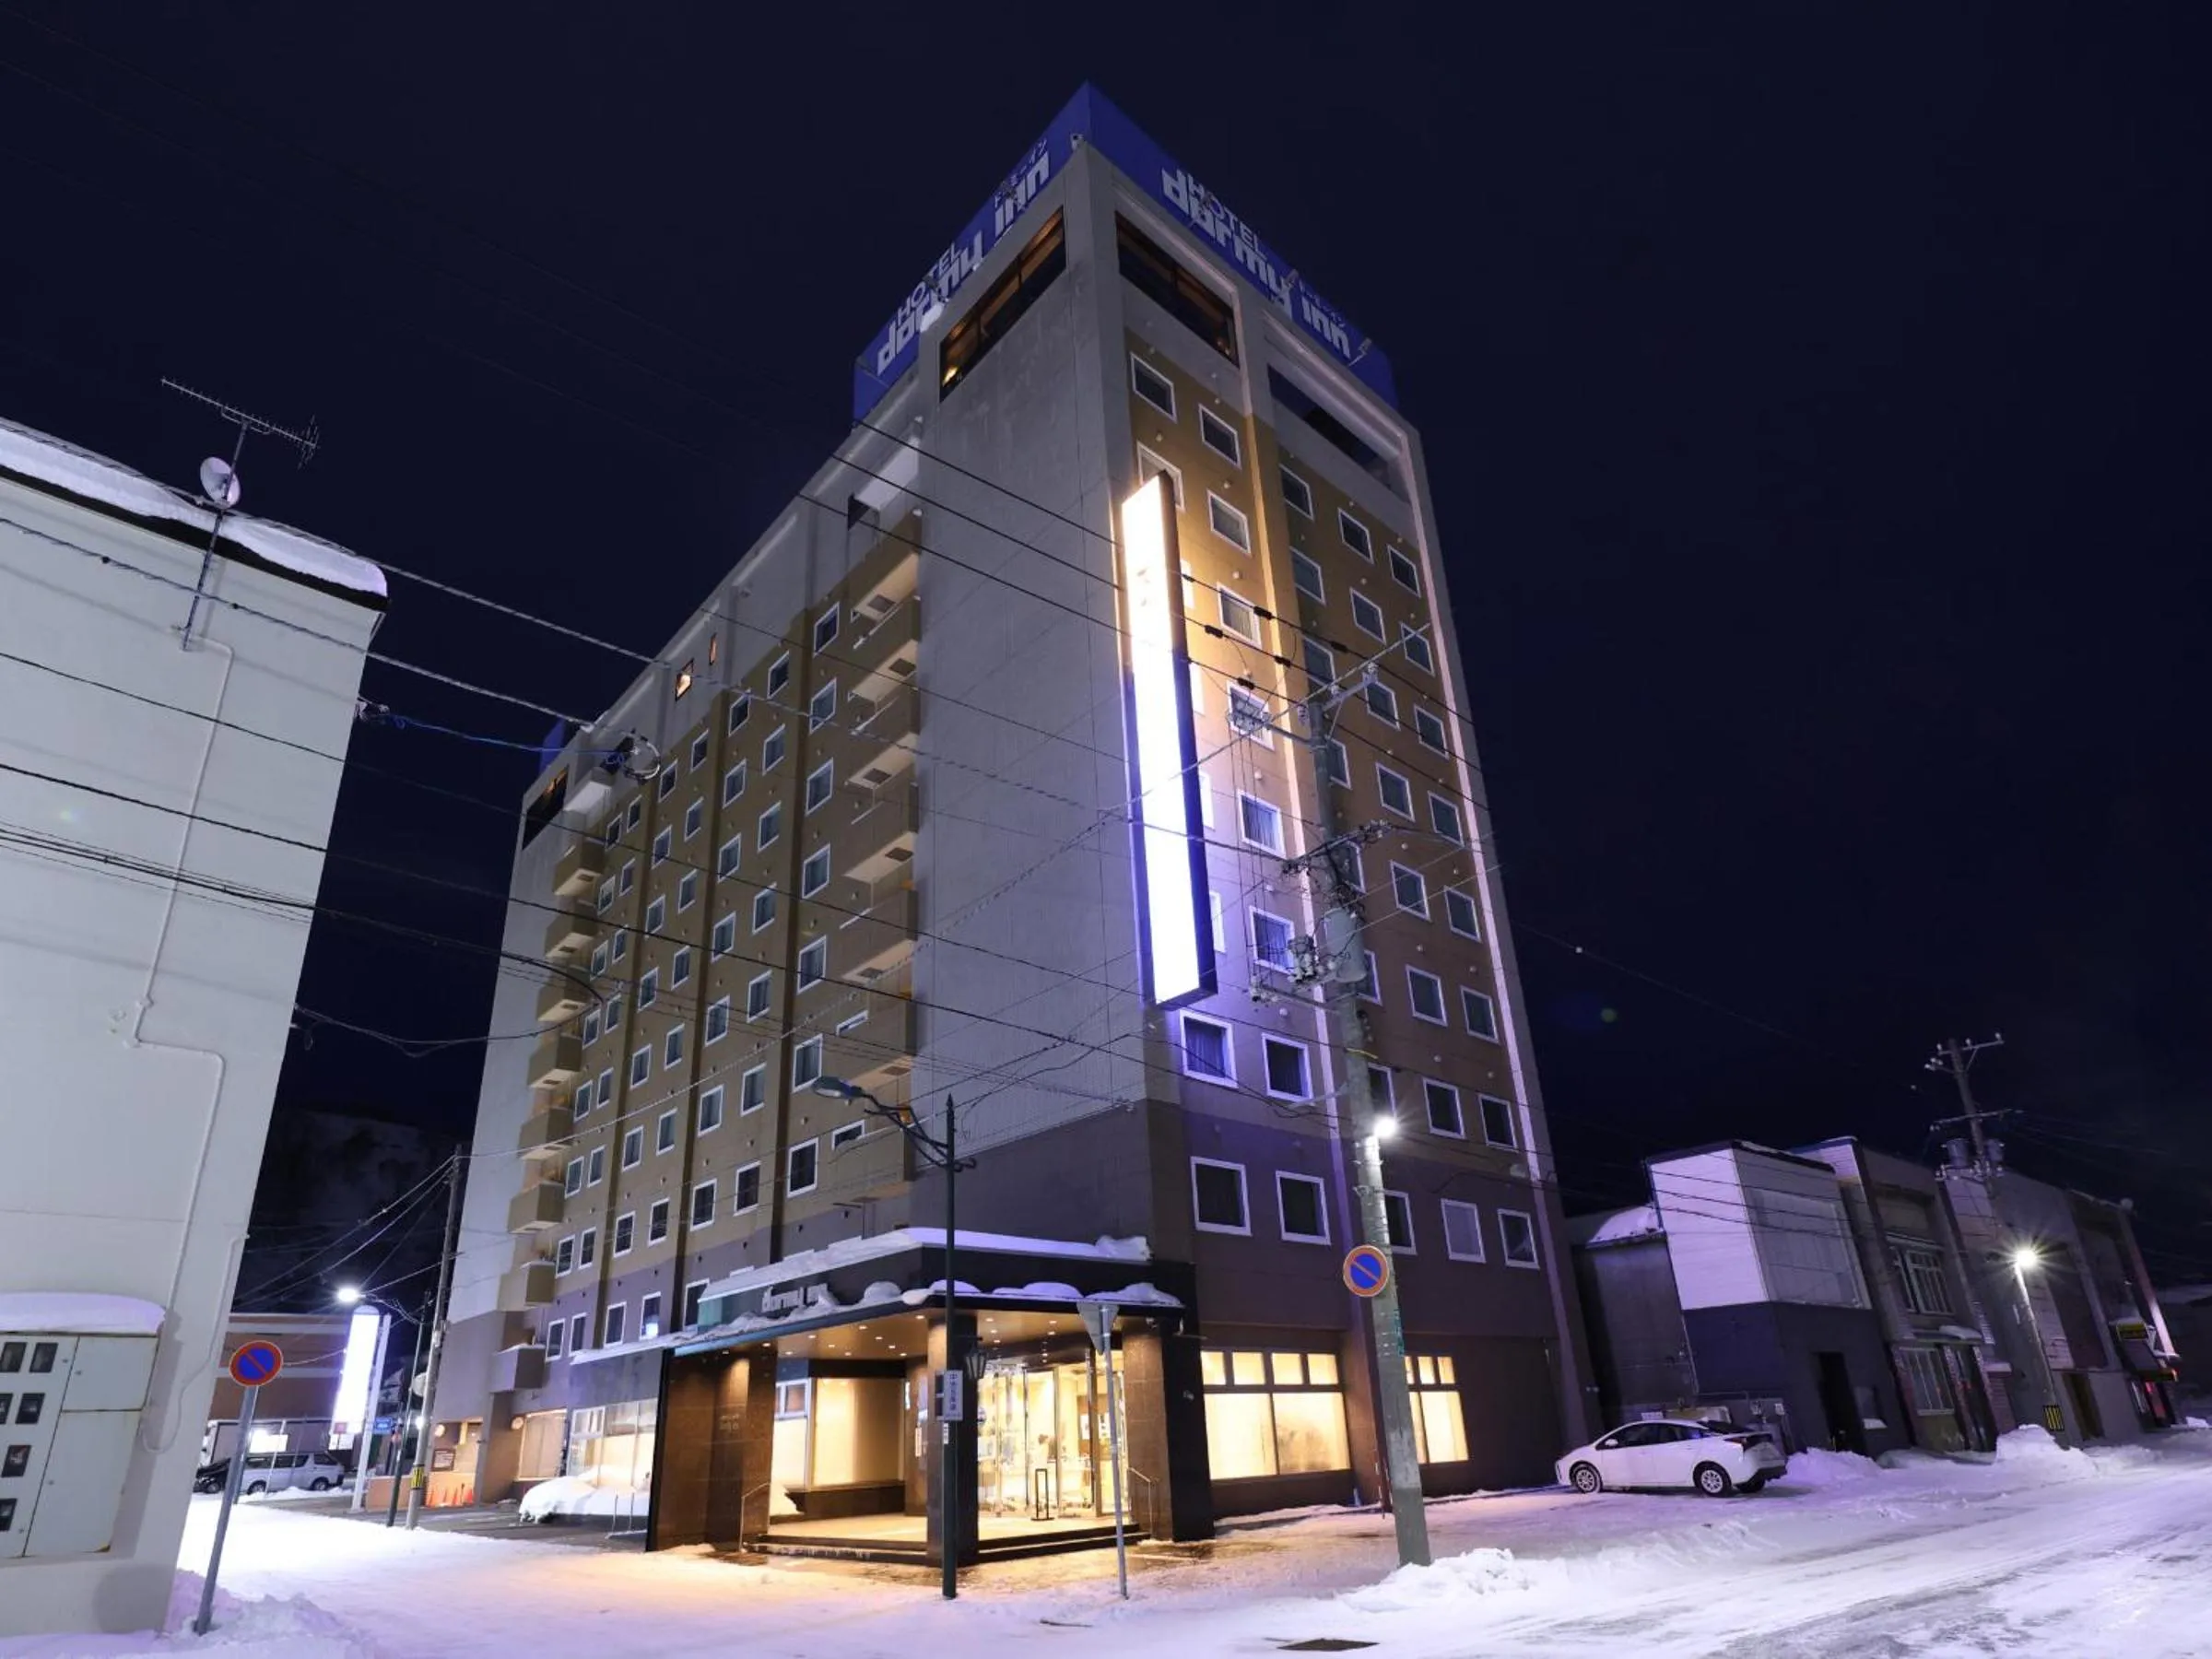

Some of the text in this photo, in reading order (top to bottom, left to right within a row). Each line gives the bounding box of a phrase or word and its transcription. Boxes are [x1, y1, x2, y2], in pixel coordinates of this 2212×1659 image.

[877, 149, 1050, 377] dormy inn
[1161, 167, 1351, 359] dormy inn
[1187, 173, 1268, 262] HOTEL
